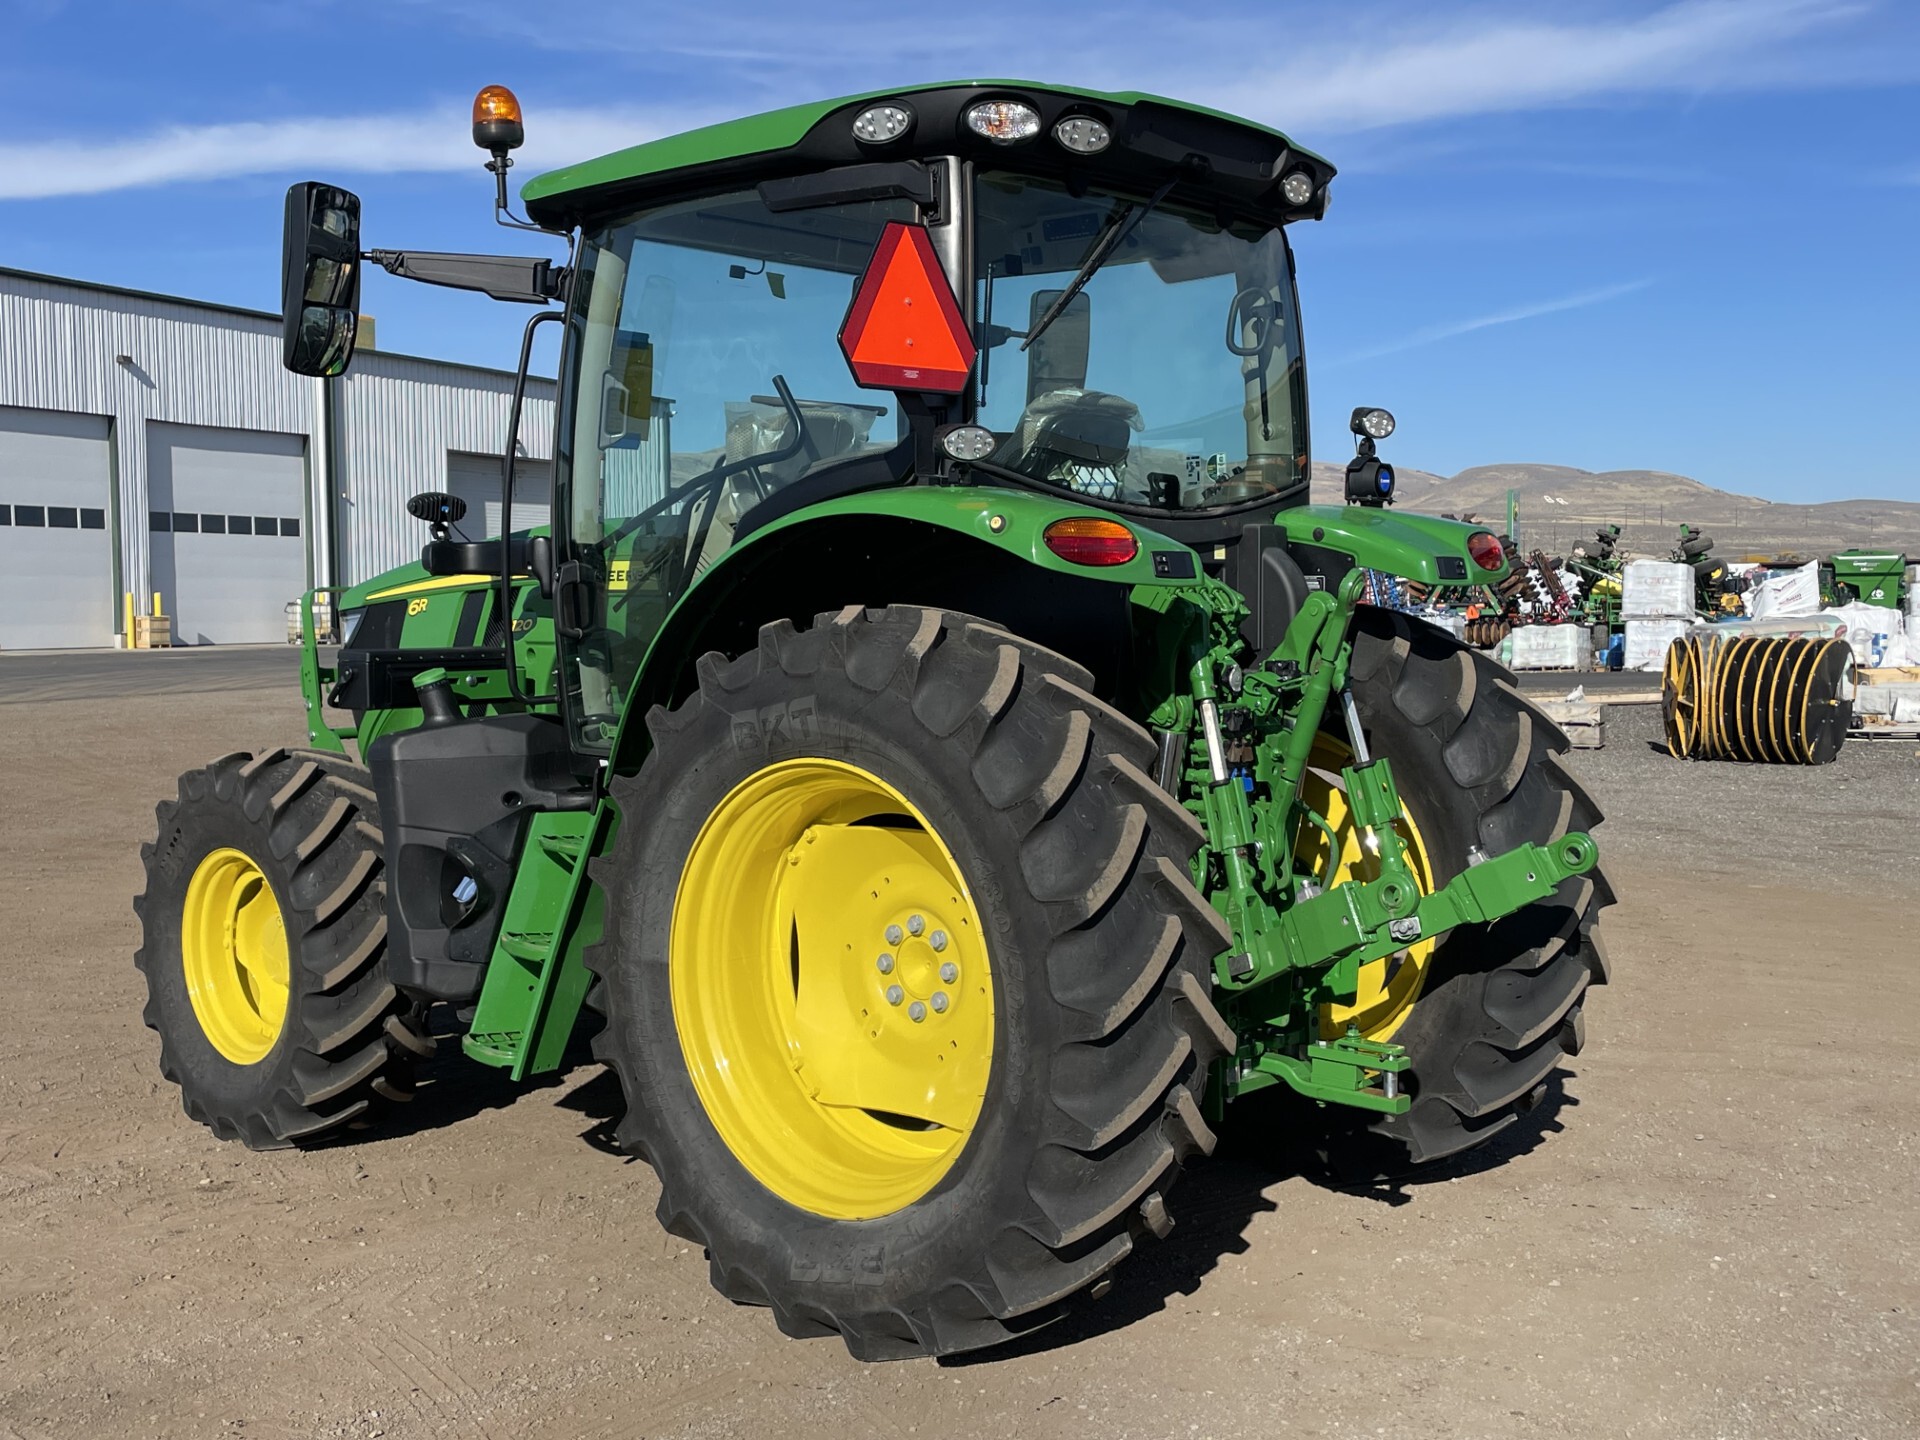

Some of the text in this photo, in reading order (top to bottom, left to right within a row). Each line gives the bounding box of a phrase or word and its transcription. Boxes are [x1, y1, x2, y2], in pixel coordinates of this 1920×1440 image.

[408, 598, 428, 616] 6R
[511, 618, 533, 632] 120
[733, 706, 814, 752] BKT
